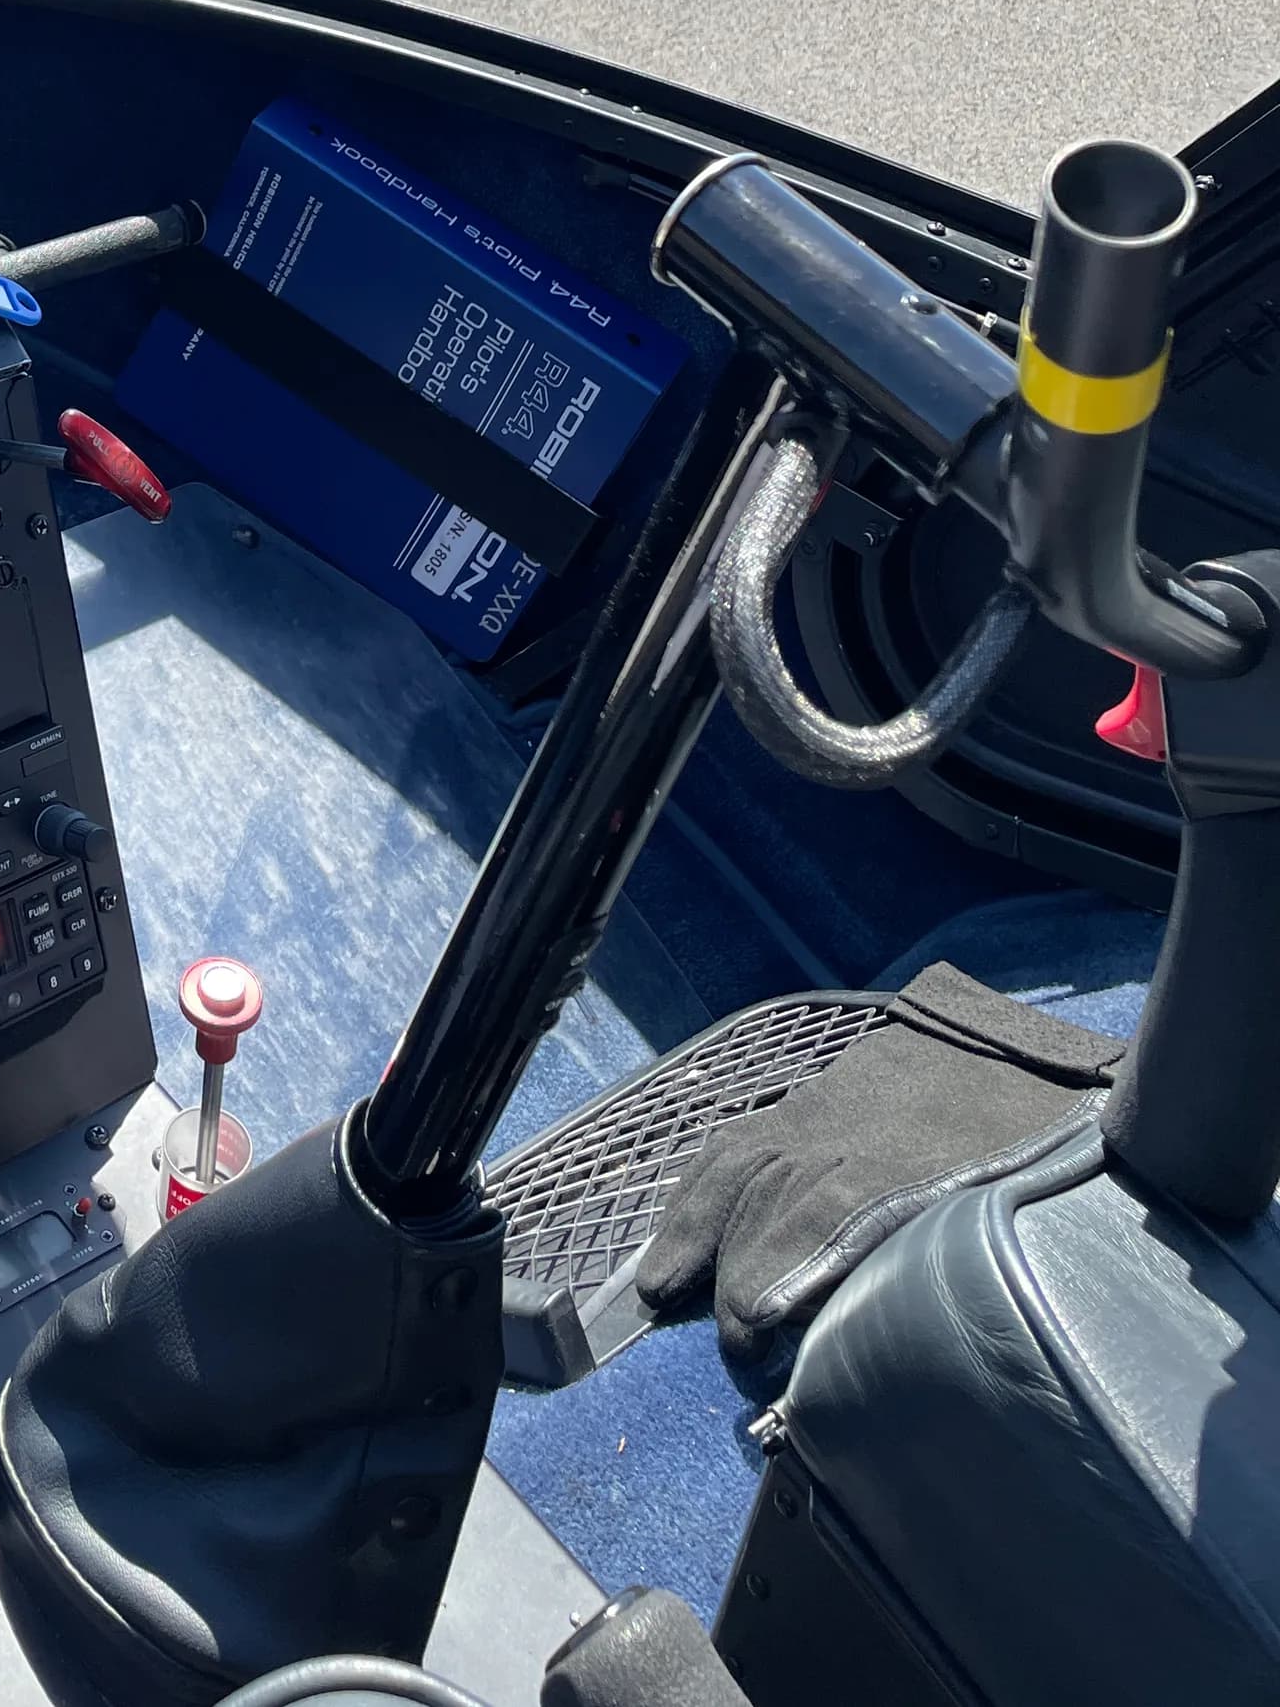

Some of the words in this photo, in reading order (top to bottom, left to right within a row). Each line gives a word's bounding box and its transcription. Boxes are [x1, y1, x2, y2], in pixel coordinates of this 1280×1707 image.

[330, 137, 458, 227] Handbook
[253, 173, 282, 229] ROBINSON
[464, 225, 543, 283] Pilot's
[460, 318, 515, 394] Pilot's
[88, 430, 110, 457] PULL
[140, 479, 162, 503] VENT
[424, 543, 452, 576] 1805
[30, 731, 62, 750] GARMIN
[61, 886, 83, 902] CRSR
[28, 902, 49, 919] FUNC
[33, 928, 55, 945] START
[71, 918, 86, 932] CLR
